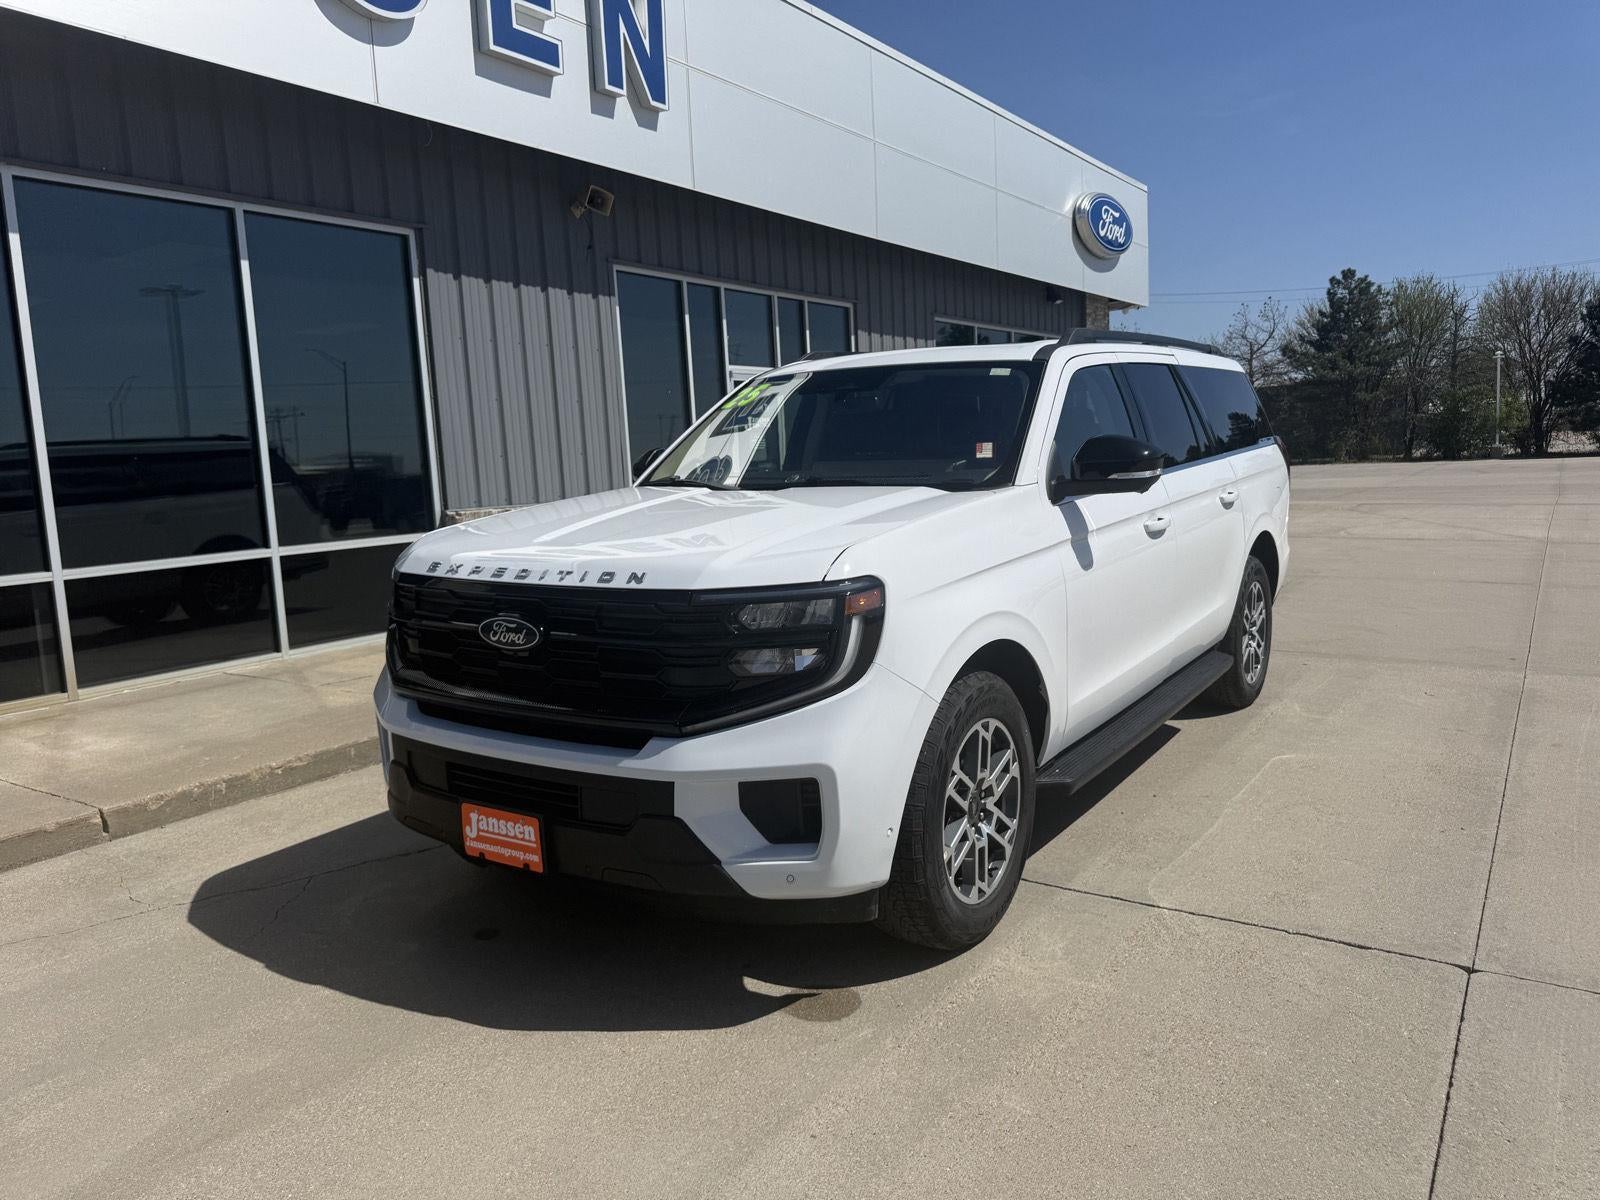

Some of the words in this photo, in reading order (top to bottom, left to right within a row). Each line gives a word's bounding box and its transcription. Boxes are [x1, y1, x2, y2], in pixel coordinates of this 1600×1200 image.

[340, 0, 669, 111] EN
[1098, 205, 1126, 244] Ford
[426, 561, 646, 585] EXPEDITION
[490, 620, 527, 644] Ford
[465, 811, 536, 842] Janssen
